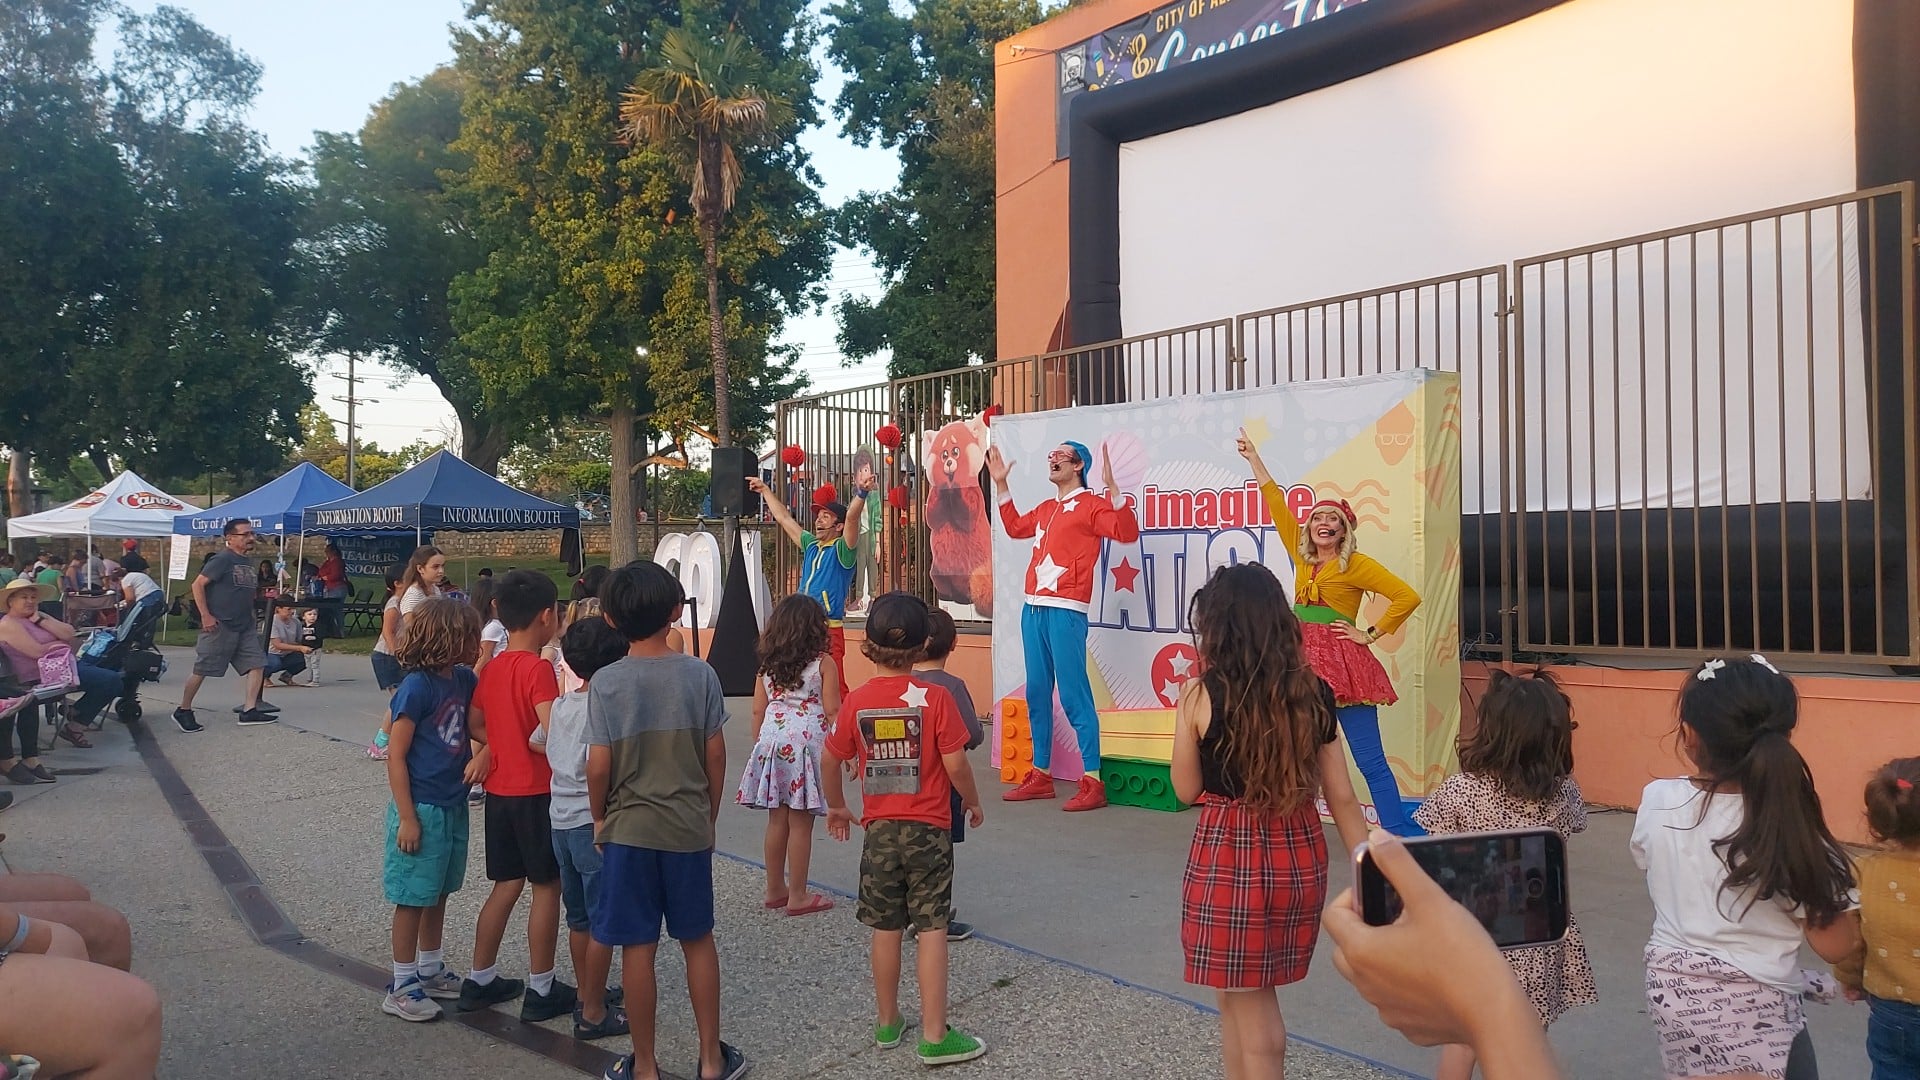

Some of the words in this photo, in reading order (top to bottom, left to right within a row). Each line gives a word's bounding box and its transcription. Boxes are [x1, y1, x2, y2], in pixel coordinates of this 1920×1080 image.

[1156, 5, 1185, 33] CITY
[1188, 0, 1205, 18] OF
[316, 508, 374, 525] INFORMATION
[373, 506, 404, 524] BOOTH
[442, 507, 521, 524] INFORMATION
[523, 508, 562, 525] BOOTH
[191, 516, 209, 533] City
[210, 516, 220, 529] of
[1665, 976, 1688, 989] LOVE
[1673, 986, 1725, 1000] Princess
[1696, 1033, 1723, 1046] LOVE
[1707, 1037, 1764, 1056] Princess
[1767, 1067, 1786, 1080] LOV
